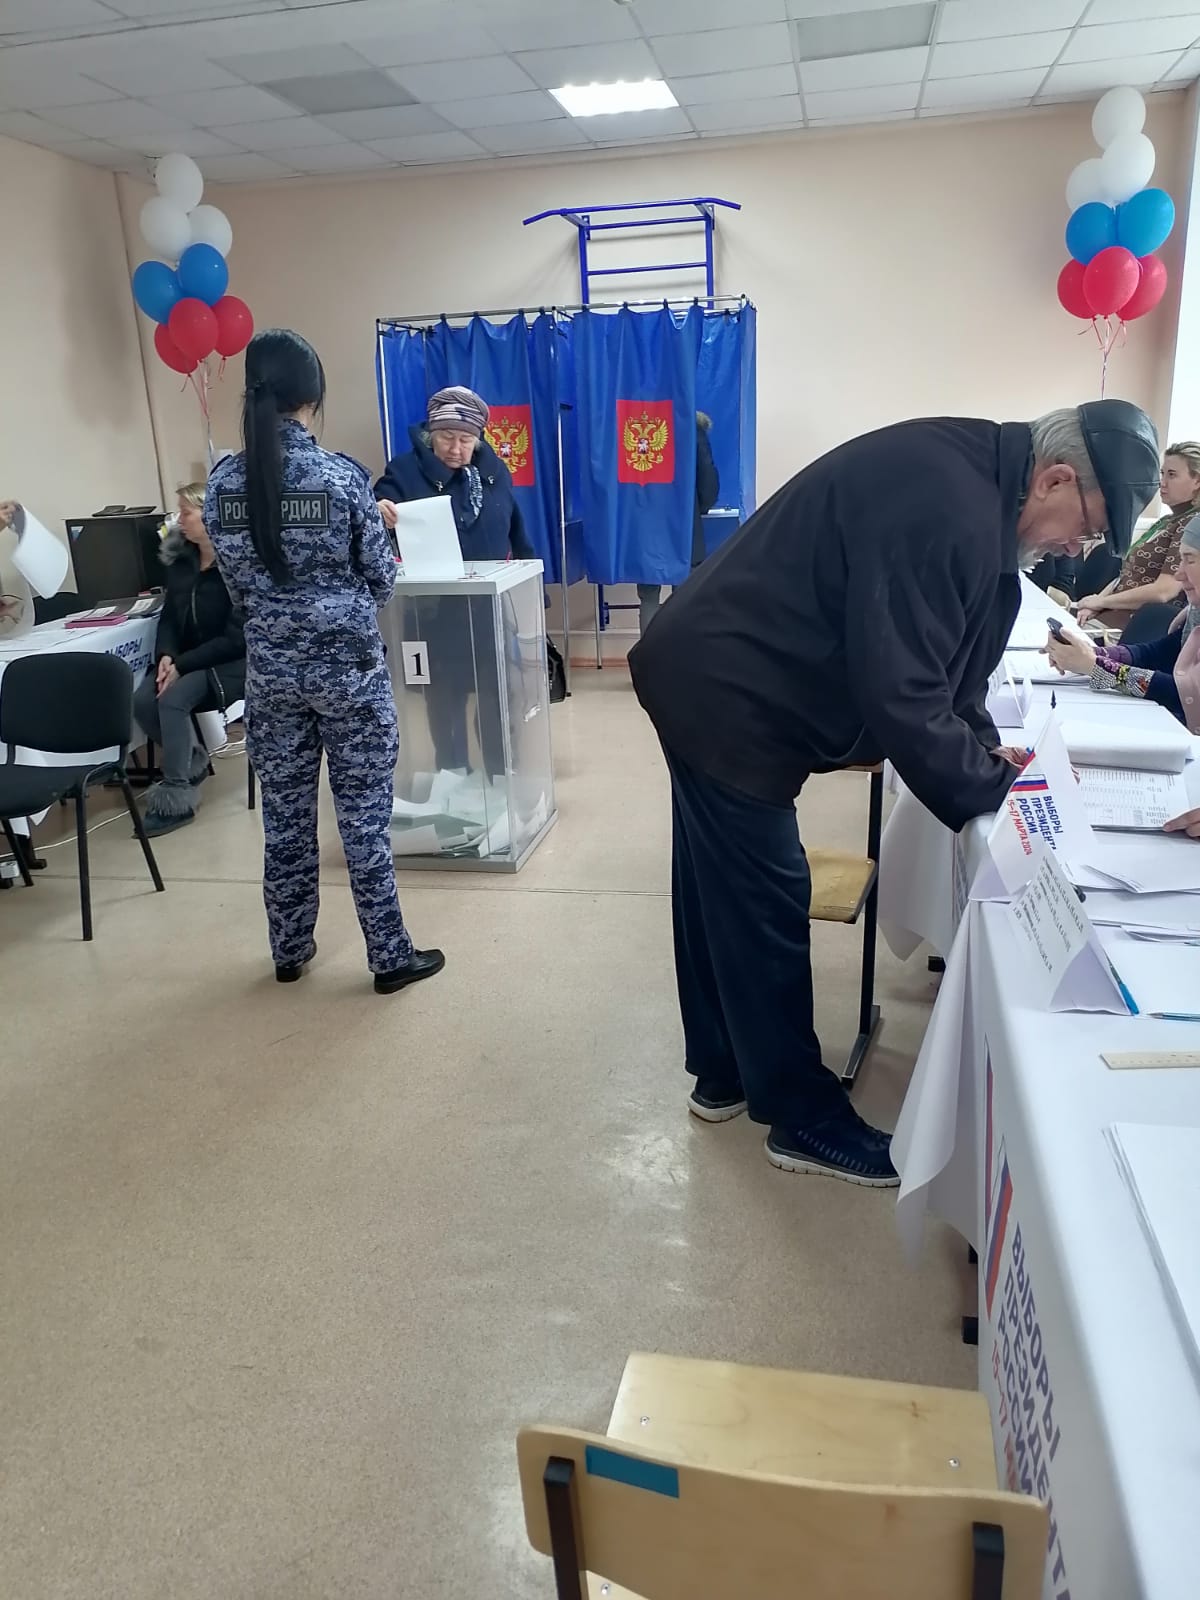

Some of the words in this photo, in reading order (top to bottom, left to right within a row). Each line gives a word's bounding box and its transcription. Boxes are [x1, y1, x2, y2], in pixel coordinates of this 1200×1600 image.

[224, 500, 322, 521] РОСРДИЯ
[411, 652, 426, 677] 1
[1012, 818, 1028, 841] МАРТА
[1016, 798, 1038, 834] РОССИИ
[1043, 795, 1063, 834] ВЫБОРЫ
[1012, 1221, 1061, 1462] ВЫБОРЫ
[998, 1302, 1033, 1495] РОССИИ
[1004, 1264, 1071, 1600] ПРЕЗИДЕНТ
